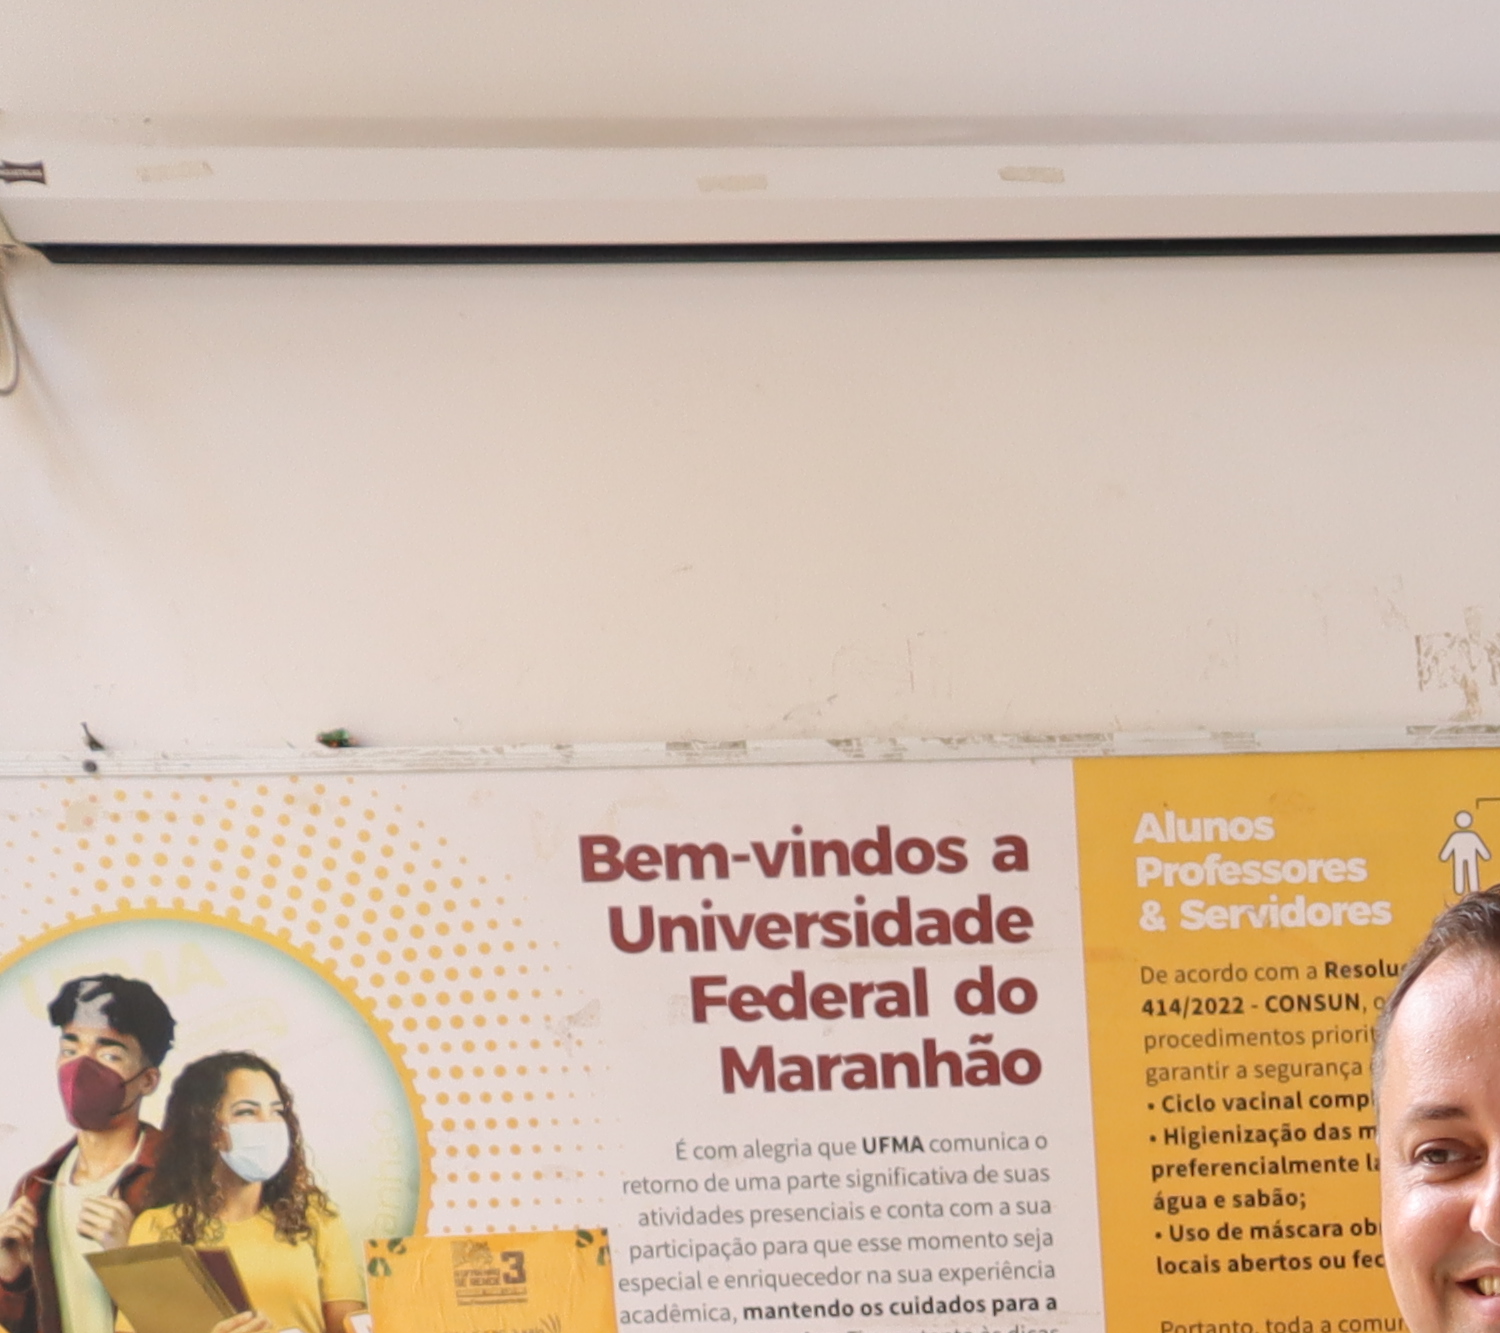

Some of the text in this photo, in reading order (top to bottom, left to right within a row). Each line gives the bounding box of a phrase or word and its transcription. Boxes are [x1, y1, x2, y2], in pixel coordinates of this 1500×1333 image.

[1134, 811, 1275, 843] Alunos
[577, 827, 1029, 885] Bem-vindos a
[1136, 853, 1368, 887] Professores
[608, 891, 1034, 955] Universidade
[1139, 895, 1392, 932] & Servidores
[691, 965, 1038, 1025] Federal do
[1141, 997, 1245, 1017] 414/2022
[1265, 993, 1367, 1015] CONSUN,
[720, 1035, 1042, 1095] Maranhão
[1145, 1058, 1363, 1087] garantir a segurança
[676, 1135, 1047, 1162] É com alegria que UFMA comunica o
[1153, 1188, 1307, 1215] água e sabão;
[500, 1251, 526, 1284] 3
[619, 1297, 1057, 1326] acadêmica, mantendo os cuidados para a
